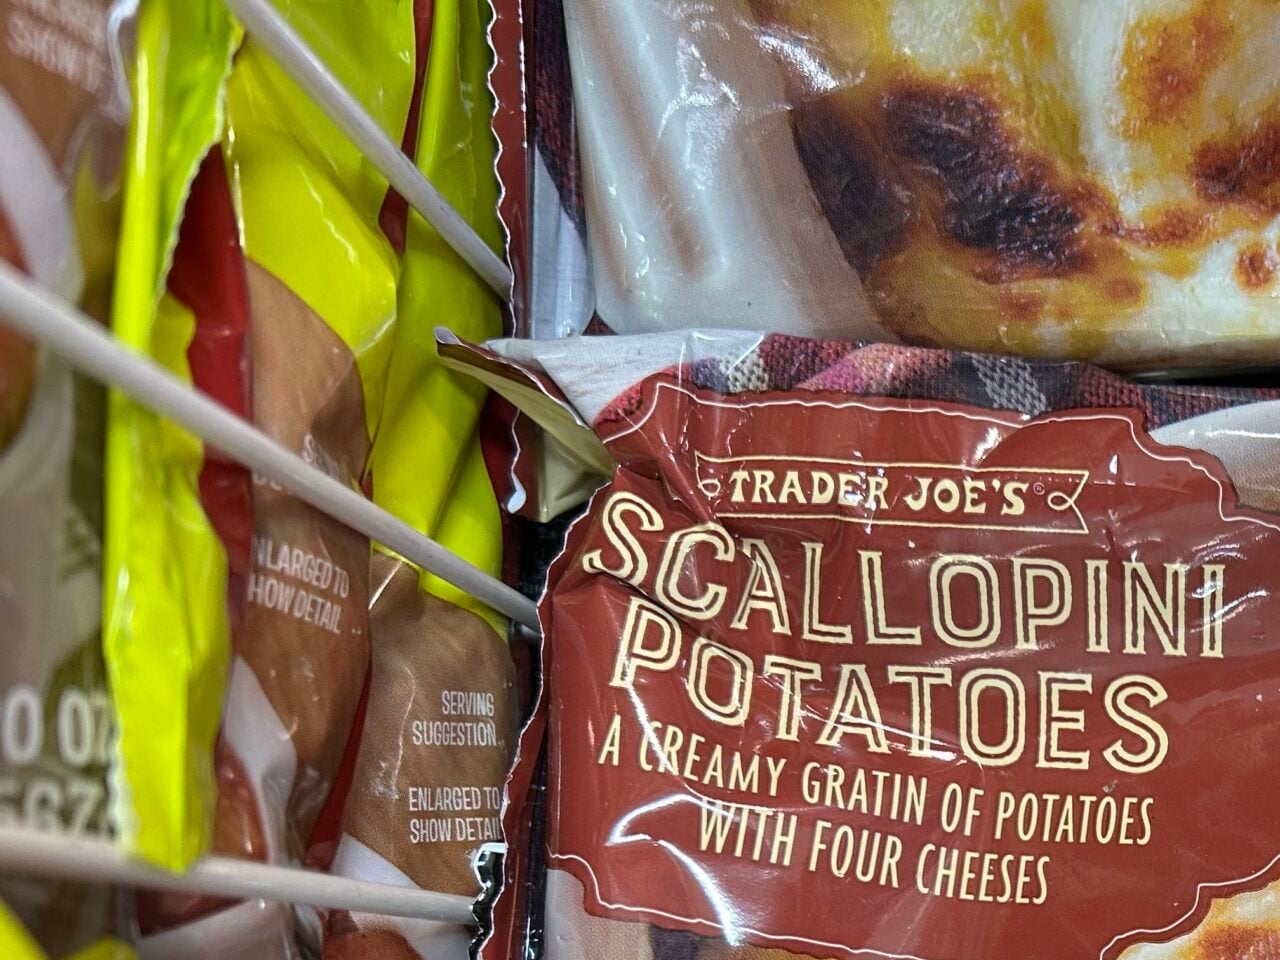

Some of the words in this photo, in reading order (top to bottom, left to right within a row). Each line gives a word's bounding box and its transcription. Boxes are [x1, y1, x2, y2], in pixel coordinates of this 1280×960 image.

[729, 469, 889, 510] TRADER
[903, 476, 1030, 516] JOE'S
[254, 536, 333, 590] NLARGED
[581, 490, 1226, 659] SCALLOPINI
[247, 572, 297, 615] HOW
[292, 593, 342, 635] DETAIL
[441, 690, 495, 717] SERVING
[608, 595, 1169, 774] POTATOES
[411, 720, 498, 747] SUGGESTION
[408, 787, 482, 812] ENLARGED
[482, 786, 501, 812] TO
[598, 714, 622, 767] A
[639, 720, 788, 797] CREAMY
[801, 761, 929, 827] GRATIN
[940, 782, 985, 838] OF
[993, 790, 1154, 846] POTATOES
[409, 818, 452, 844] SHOW
[454, 816, 503, 842] DETAIL
[699, 797, 798, 868] WITH
[807, 819, 903, 889] FOUR
[915, 843, 1051, 906] CHEESES
